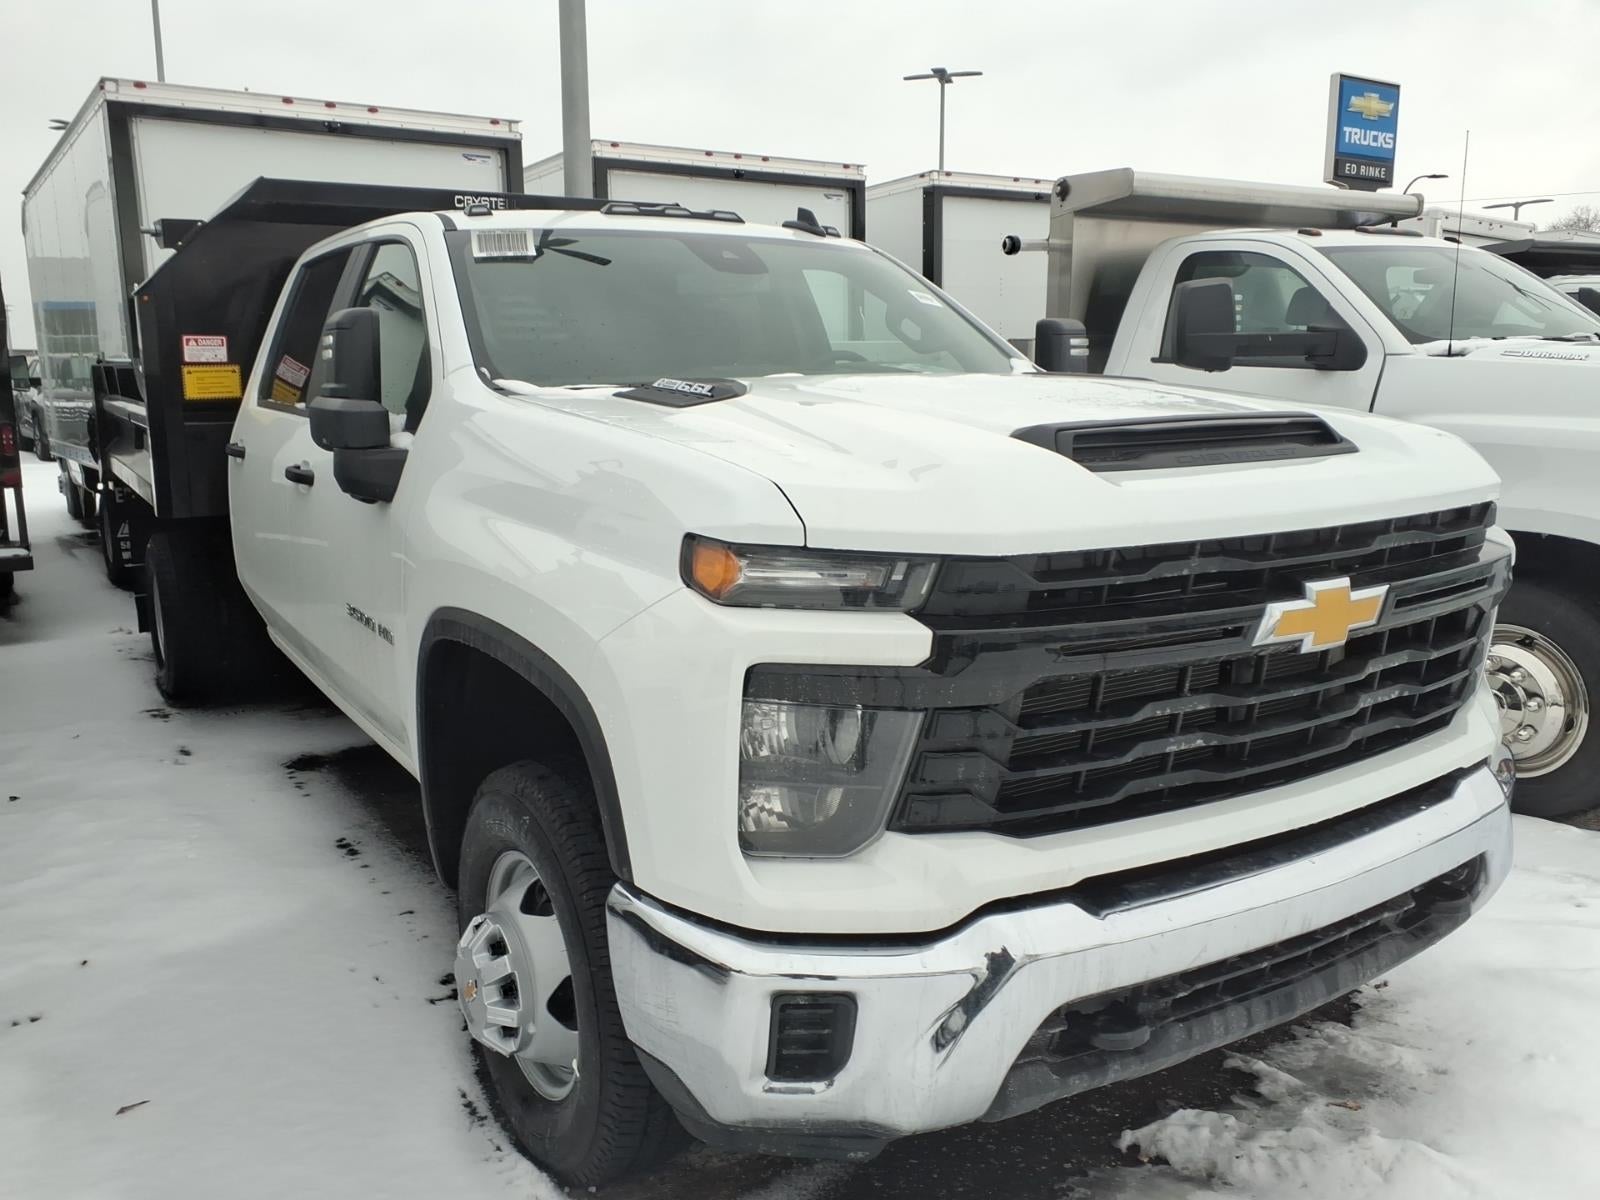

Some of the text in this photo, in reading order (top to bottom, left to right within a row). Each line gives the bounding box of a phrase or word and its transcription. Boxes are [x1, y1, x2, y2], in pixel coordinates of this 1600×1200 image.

[1343, 126, 1394, 149] TRUCKS
[1345, 163, 1386, 178] ED RINKE
[454, 195, 516, 210] CRYSTE
[1175, 447, 1297, 464] CHEVROLET
